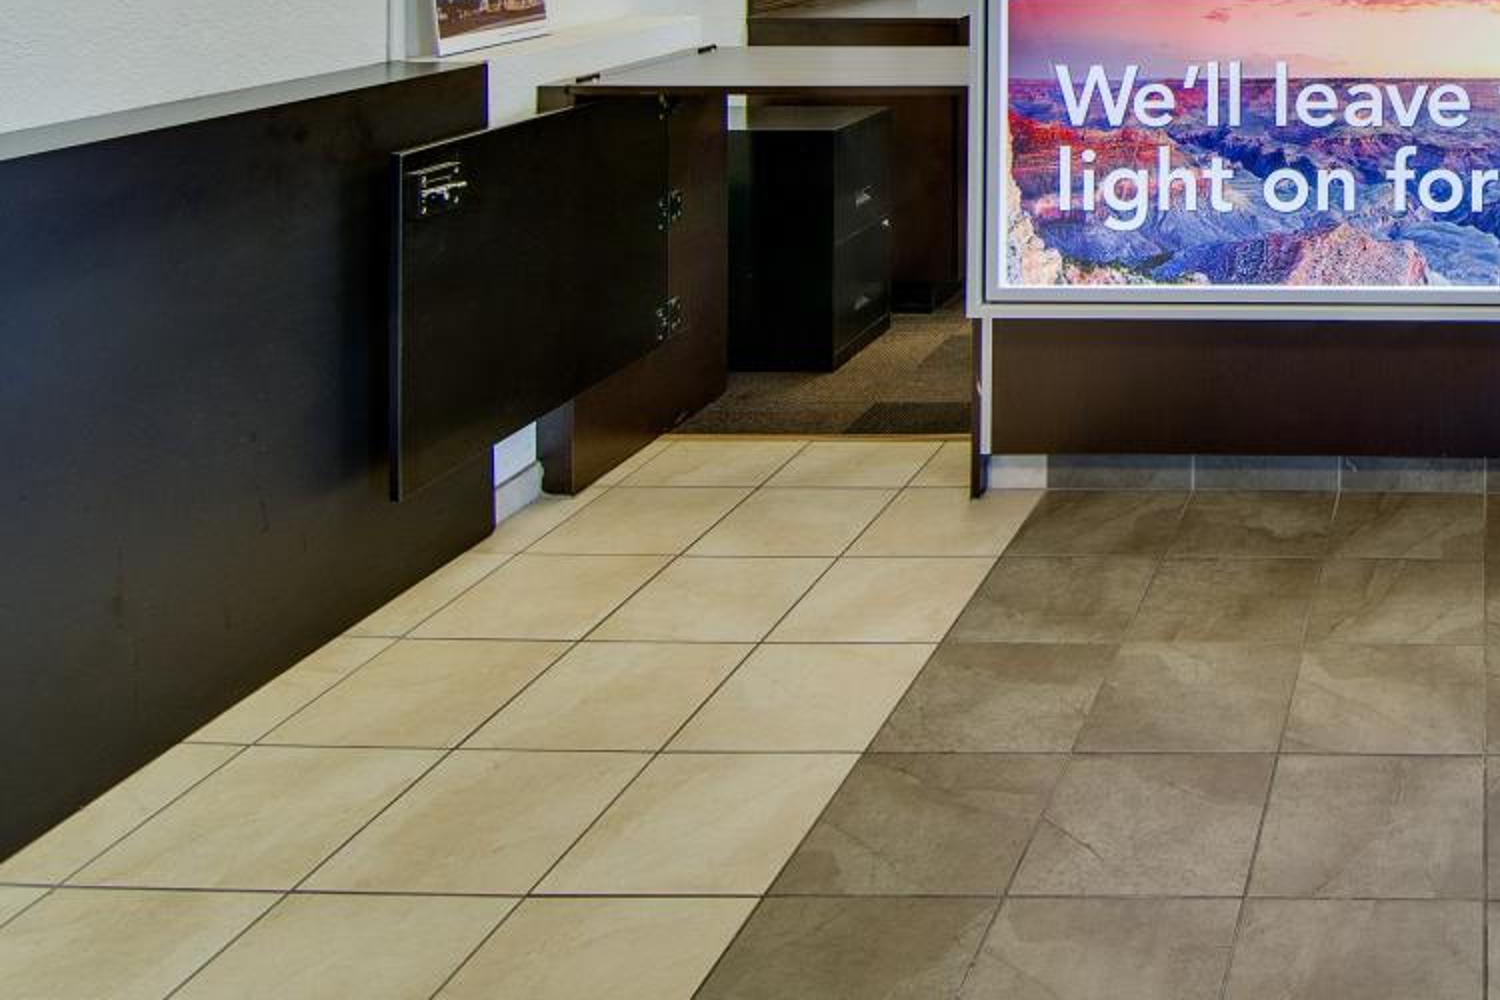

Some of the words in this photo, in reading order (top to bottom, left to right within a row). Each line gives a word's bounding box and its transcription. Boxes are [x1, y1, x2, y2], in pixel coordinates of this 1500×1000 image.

[1055, 60, 1242, 129] We'll
[1275, 60, 1471, 129] leave
[1057, 144, 1234, 231] light
[1263, 165, 1356, 214] on
[1388, 145, 1499, 214] for
